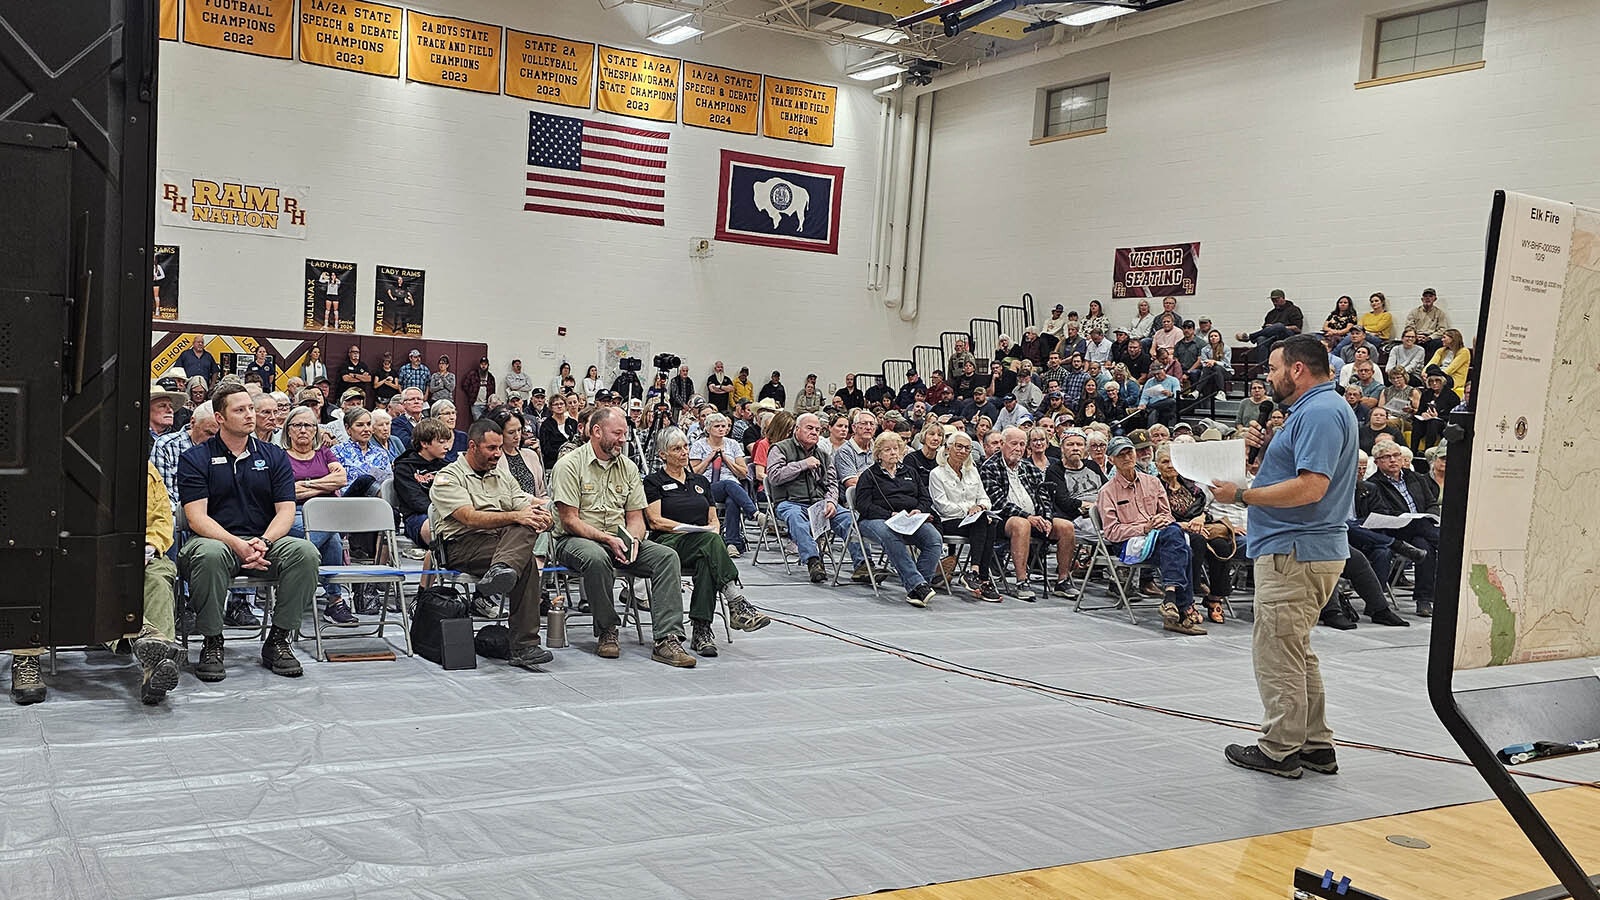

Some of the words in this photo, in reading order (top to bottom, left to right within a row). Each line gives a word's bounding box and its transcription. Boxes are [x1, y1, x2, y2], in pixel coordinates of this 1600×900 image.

[204, 0, 273, 17] FOOTBALL
[311, 0, 347, 15] 1A/2A
[354, 7, 391, 24] STATE
[202, 11, 276, 33] CHAMPIONS
[302, 13, 342, 30] SPEECH
[347, 22, 354, 32] &
[361, 24, 398, 40] DEBATE
[223, 31, 254, 45] 2022
[421, 21, 434, 33] 2A
[436, 23, 458, 36] BOYS
[460, 27, 489, 42] STATE
[316, 32, 384, 53] CHAMPIONS
[416, 35, 446, 50] TRACK
[448, 41, 466, 53] AND
[468, 44, 494, 57] FIELD
[524, 39, 557, 53] STATE
[562, 46, 576, 57] 2A
[336, 51, 364, 65] 2023
[430, 53, 480, 70] CHAMPIONS
[522, 53, 578, 72] VOLLEYBALL
[607, 54, 638, 67] STATE
[643, 60, 671, 74] 1A/2A
[441, 70, 468, 82] 2023
[520, 68, 578, 86] CHAMPIONS
[603, 67, 675, 88] THESPIAN/DRAMA
[692, 69, 719, 82] 1A/2A
[724, 75, 753, 88] STATE
[536, 85, 561, 97] 2023
[599, 80, 626, 94] STATE
[630, 86, 677, 101] CHAMPIONS
[685, 81, 715, 95] SPEECH
[719, 87, 724, 96] &
[729, 89, 757, 102] DEBATE
[775, 84, 784, 94] 2A
[785, 86, 803, 96] BOYS
[804, 88, 826, 101] STATE
[626, 100, 649, 111] 2023
[695, 97, 747, 114] CHAMPIONS
[771, 96, 793, 108] TRACK
[794, 101, 808, 110] AND
[809, 103, 830, 114] FIELD
[709, 113, 731, 125] 2024
[780, 111, 818, 125] CHAMPIONS
[788, 125, 808, 136] 2024
[192, 178, 280, 213] RAM
[192, 205, 279, 229] NATION
[1530, 207, 1543, 221] Elk
[1544, 210, 1560, 224] Fire
[310, 260, 332, 268] LADY
[332, 262, 353, 271] RAMS
[1129, 248, 1183, 268] VISITOR
[381, 267, 399, 276] LADY
[401, 269, 421, 278] RAMS
[1125, 268, 1183, 288] SEATING
[306, 279, 316, 327] MULLINAX
[375, 299, 385, 332] BAILEY
[153, 357, 169, 371] BIG
[167, 337, 190, 359] HORN
[241, 337, 257, 353] LAD
